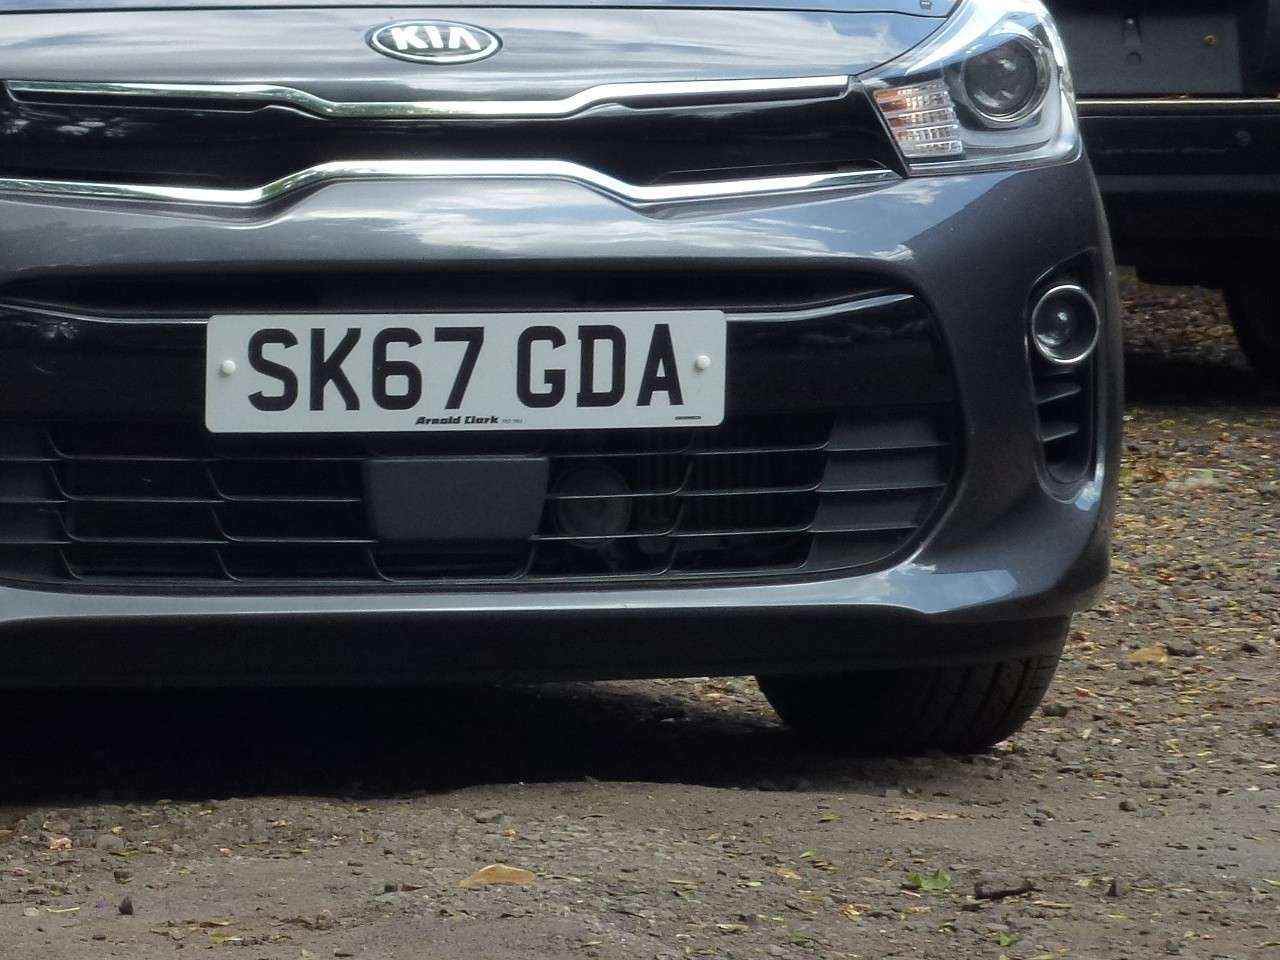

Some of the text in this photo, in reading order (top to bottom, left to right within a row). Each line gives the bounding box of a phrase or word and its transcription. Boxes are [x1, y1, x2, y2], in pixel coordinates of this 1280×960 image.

[390, 25, 482, 51] KIA
[247, 323, 684, 412] SK67 GDA
[416, 416, 461, 425] Arnold
[464, 415, 498, 424] Clark
